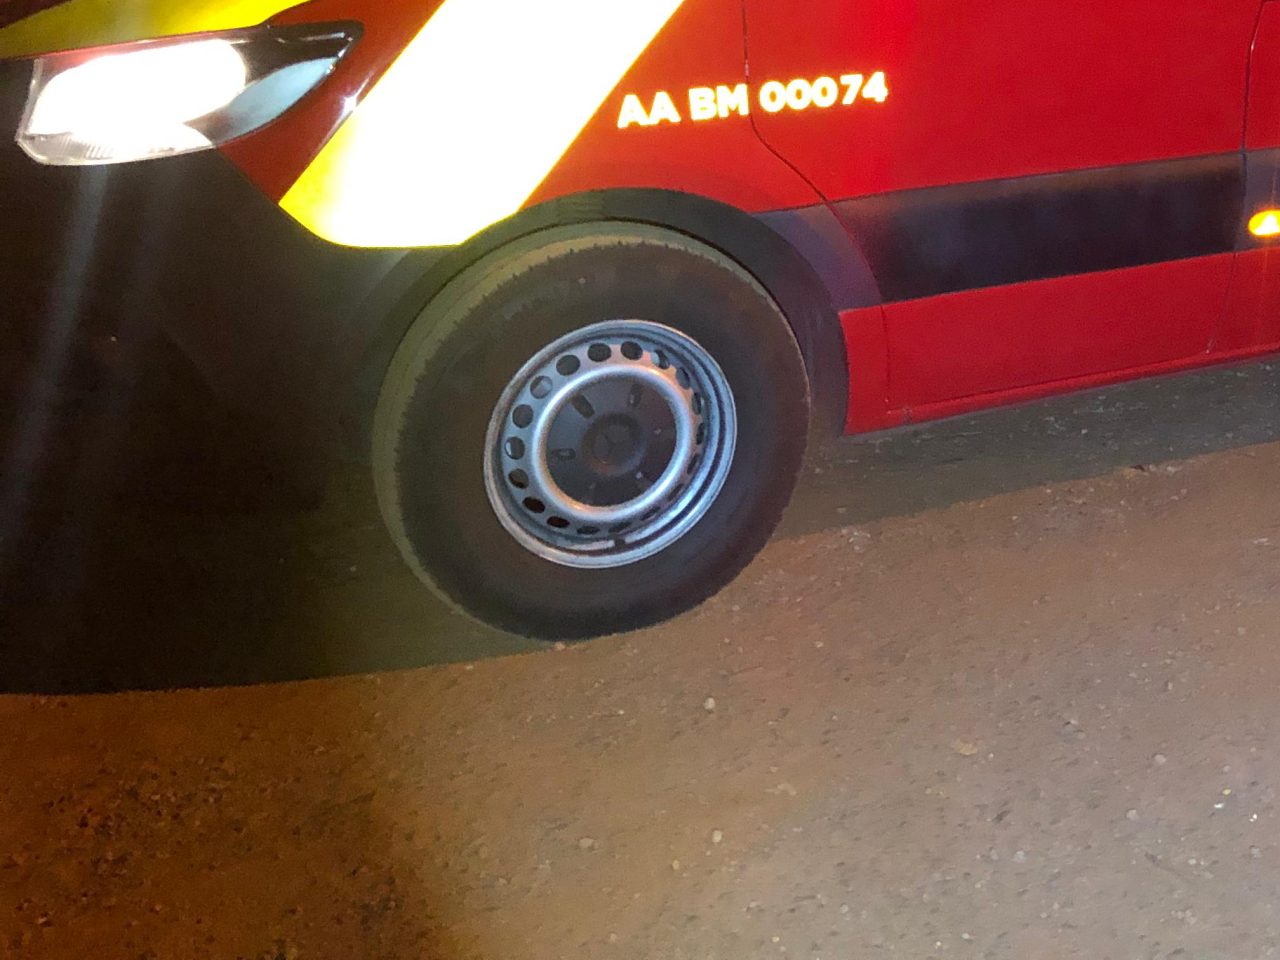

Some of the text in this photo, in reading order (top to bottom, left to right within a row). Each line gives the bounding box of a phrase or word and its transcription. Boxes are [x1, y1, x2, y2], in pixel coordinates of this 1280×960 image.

[617, 71, 888, 129] AA BM 00074
